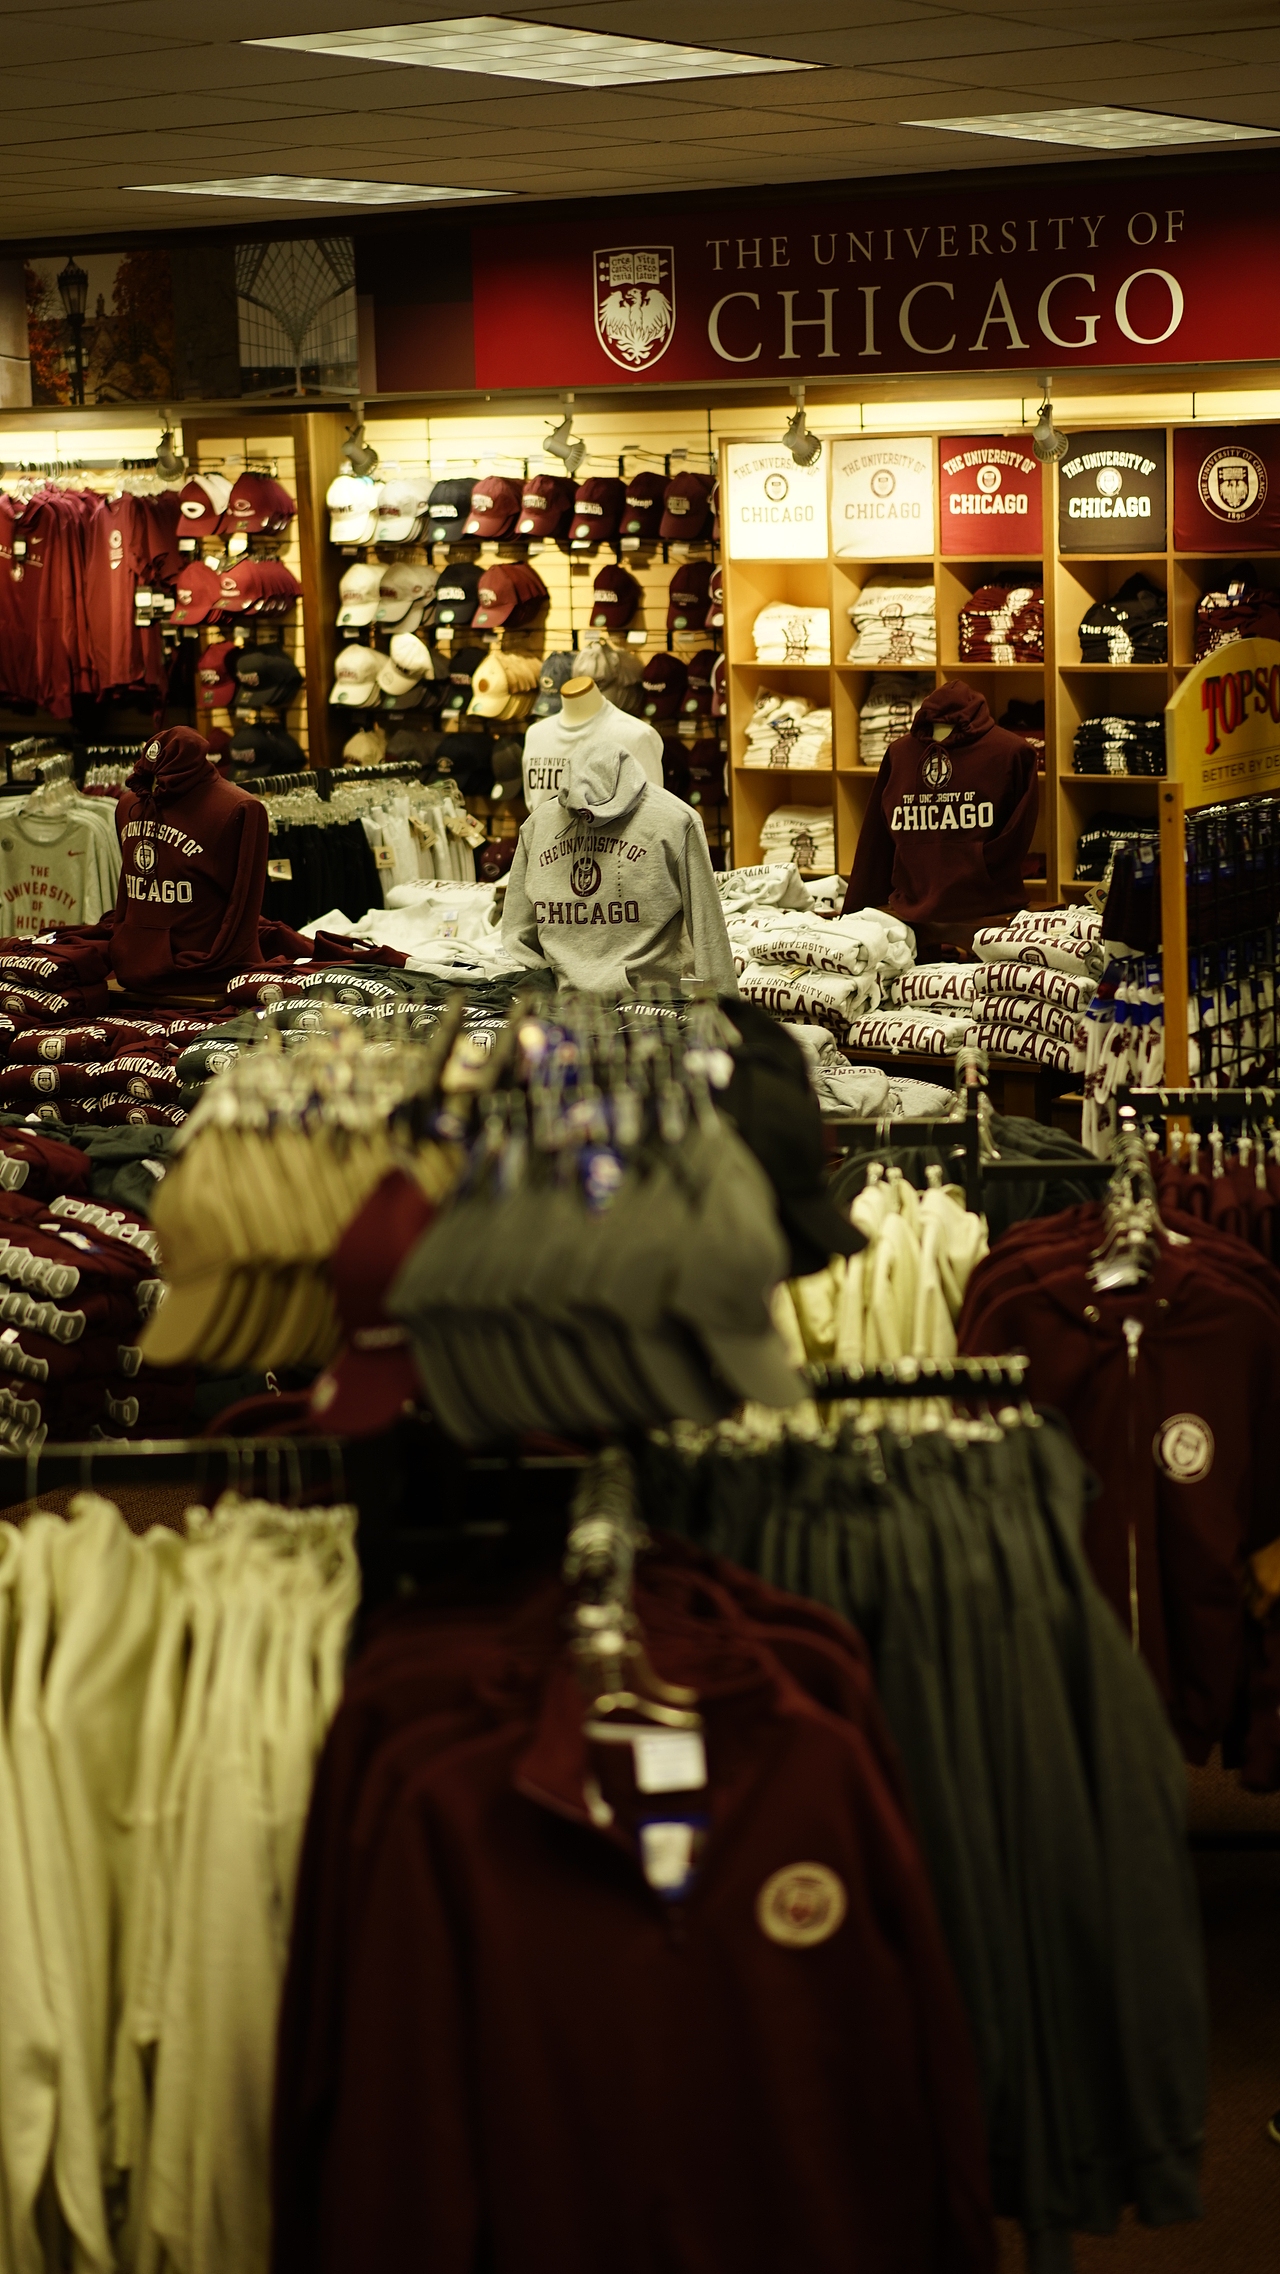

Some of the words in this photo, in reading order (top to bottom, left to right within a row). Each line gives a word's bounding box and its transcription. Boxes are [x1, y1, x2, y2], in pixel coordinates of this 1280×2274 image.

[706, 236, 791, 271] THE
[812, 214, 1106, 265] UNIVERSITY
[1127, 209, 1186, 245] OF
[706, 267, 1185, 363] CHICAGO
[733, 462, 752, 480] THE
[841, 460, 860, 477] THE
[862, 452, 914, 468] UNIVERSITY
[916, 462, 926, 474] OF
[942, 456, 965, 476] THE
[964, 449, 1021, 468] UNIVERSITY
[1020, 458, 1037, 474] OF
[1061, 458, 1083, 479] THE
[1082, 451, 1141, 470] UNIVERSITY
[1139, 459, 1157, 476] OF
[1201, 449, 1241, 481] UNIVERSITY
[1242, 452, 1254, 461] OF
[1252, 460, 1266, 500] CHICAGO
[741, 505, 815, 523] CHICAGO
[844, 502, 921, 519] CHICAGO
[949, 493, 1028, 514] CHICAGO
[1068, 496, 1151, 518] CHICAGO
[528, 768, 563, 790] CHIC
[1202, 761, 1246, 784] BETTER
[1249, 758, 1264, 773] BY
[964, 791, 975, 801] OF
[890, 801, 994, 831] CHICAGO
[181, 839, 204, 857] OF
[539, 845, 559, 867] THE
[626, 845, 647, 862] OF
[31, 865, 49, 878] THE
[4, 881, 76, 910] UNIVERSITY
[32, 900, 43, 912] OF
[533, 900, 639, 924] CHICAGO
[750, 943, 768, 956] THE
[771, 940, 831, 956] UNIVERSITY
[39, 961, 59, 978] OF
[300, 973, 325, 990] THE
[744, 977, 764, 986] THE
[766, 977, 822, 999] UNIVERSITY
[824, 994, 836, 1005] OF
[973, 964, 1080, 1013] CHICAGO
[49, 995, 69, 1014] OF
[971, 996, 1074, 1043] CHICAGO
[849, 1020, 946, 1055] CHICAGO
[963, 1024, 1071, 1073] CHICAGO
